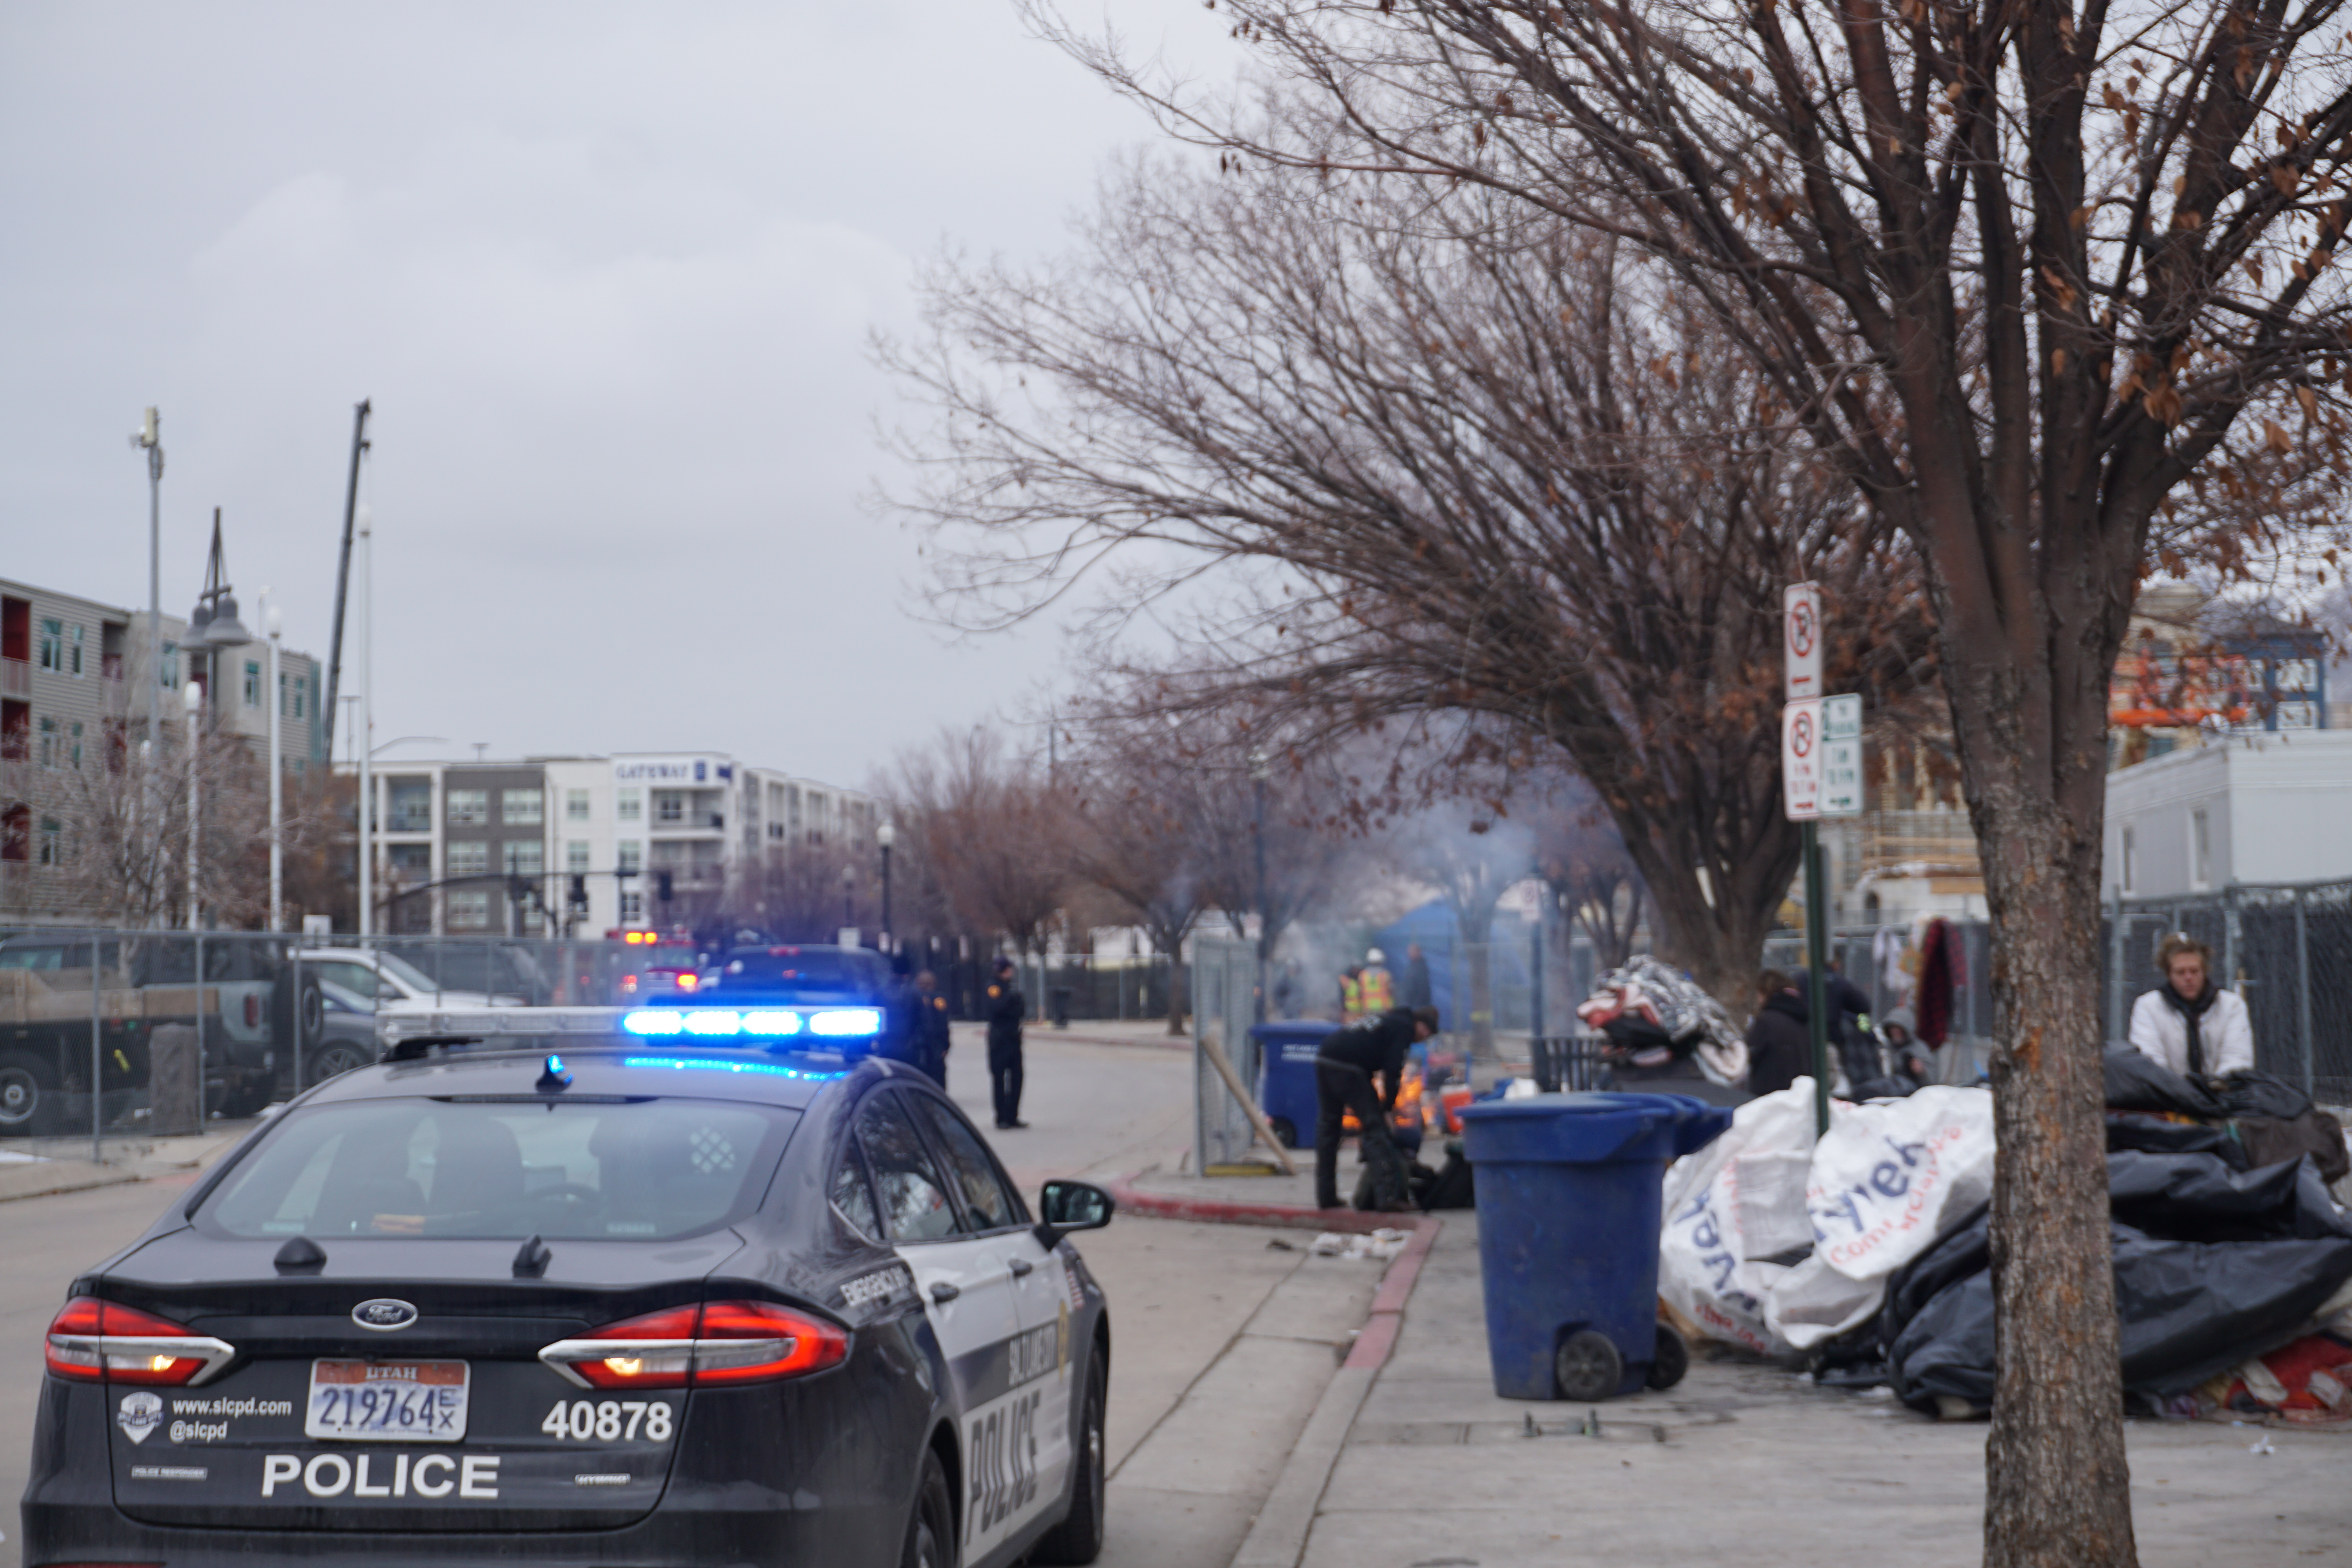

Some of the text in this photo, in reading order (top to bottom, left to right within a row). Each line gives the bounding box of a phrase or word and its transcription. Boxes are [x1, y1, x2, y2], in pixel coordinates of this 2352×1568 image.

[616, 764, 687, 779] GATEWAY
[365, 1305, 404, 1323] Ford
[364, 1366, 418, 1381] UTAH
[172, 1397, 292, 1419] www.slcpd.com
[319, 1387, 435, 1427] 219764
[169, 1419, 228, 1443] @slcpd
[541, 1399, 672, 1442] 40878
[134, 1467, 160, 1477] POLICE
[261, 1454, 501, 1499] POLICE
[964, 1388, 1041, 1546] POLICE
